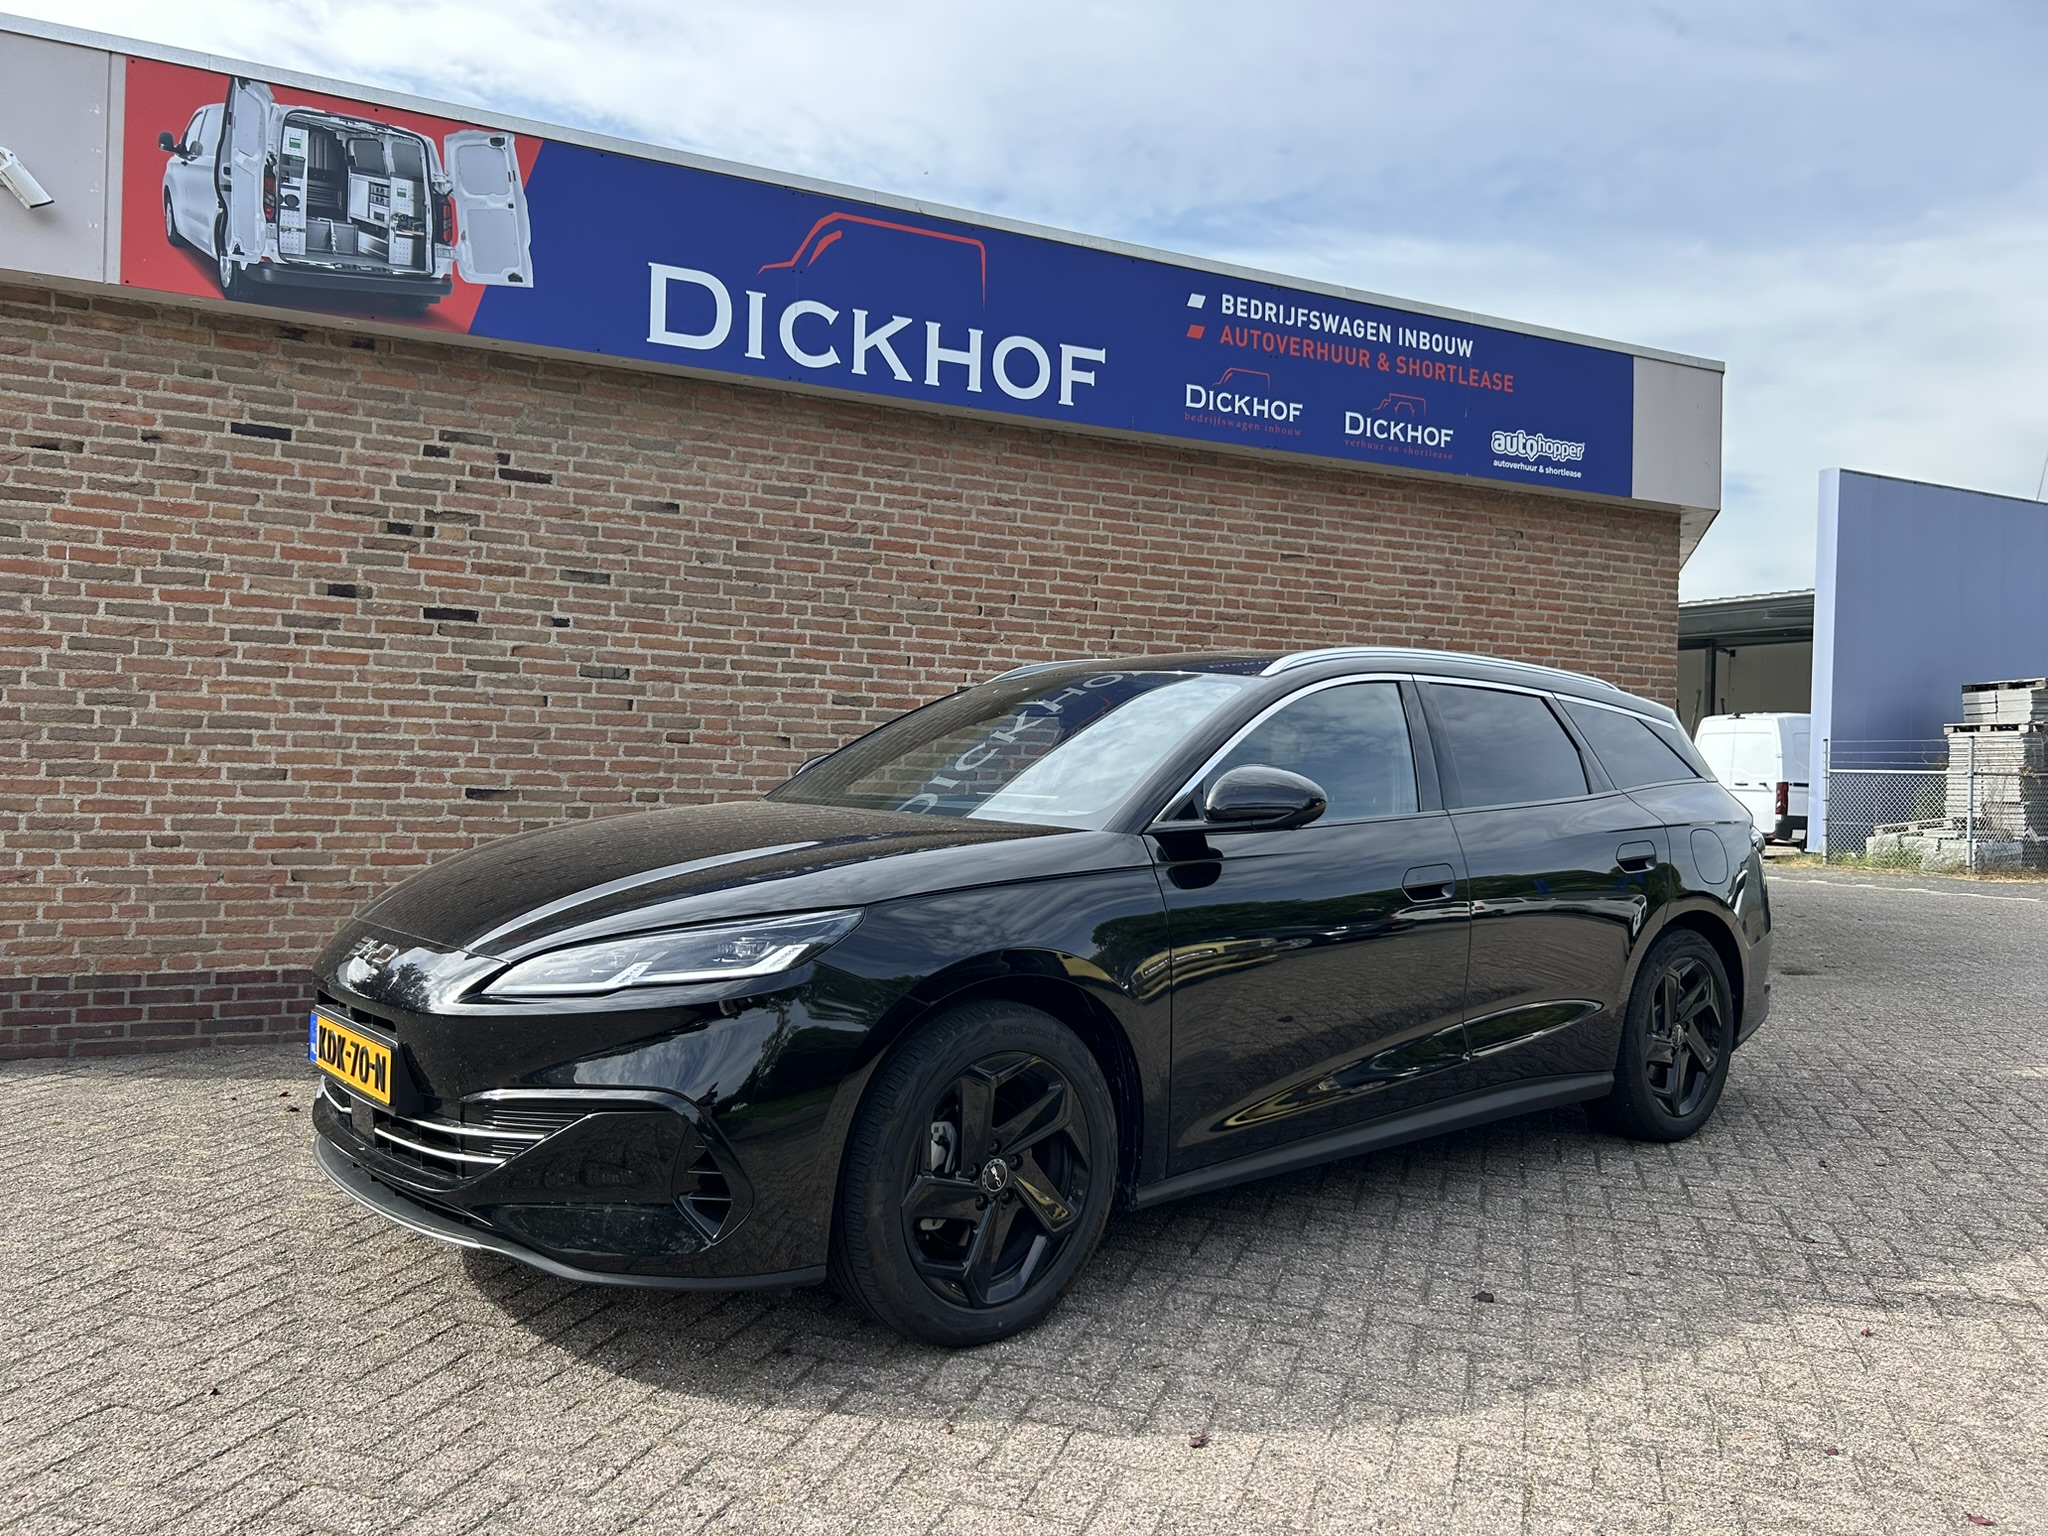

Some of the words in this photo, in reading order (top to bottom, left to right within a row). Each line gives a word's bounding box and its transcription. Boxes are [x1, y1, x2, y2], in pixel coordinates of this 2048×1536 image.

[646, 262, 1106, 406] DICKHOF
[1221, 294, 1391, 343] BEDRIJFSWAGEN
[1398, 327, 1474, 358] INBOUW
[1219, 325, 1370, 369] AUTOVERHUUR
[1377, 352, 1390, 372] &
[1396, 355, 1514, 393] SHORTLEASE
[1185, 383, 1303, 422] DICKHOF
[1184, 412, 1260, 432] bedrijfswagen
[1264, 424, 1302, 436] inbouw
[1344, 411, 1454, 448] DICKHOF
[1344, 439, 1384, 451] verhuur
[1388, 444, 1399, 453] en
[1403, 445, 1454, 461] shortlease
[1491, 430, 1584, 462] autohopper
[1492, 459, 1537, 473] autoverhuur
[1538, 465, 1544, 473] &
[1545, 466, 1582, 478] shortlease
[318, 1024, 387, 1095] KDK-70-N
